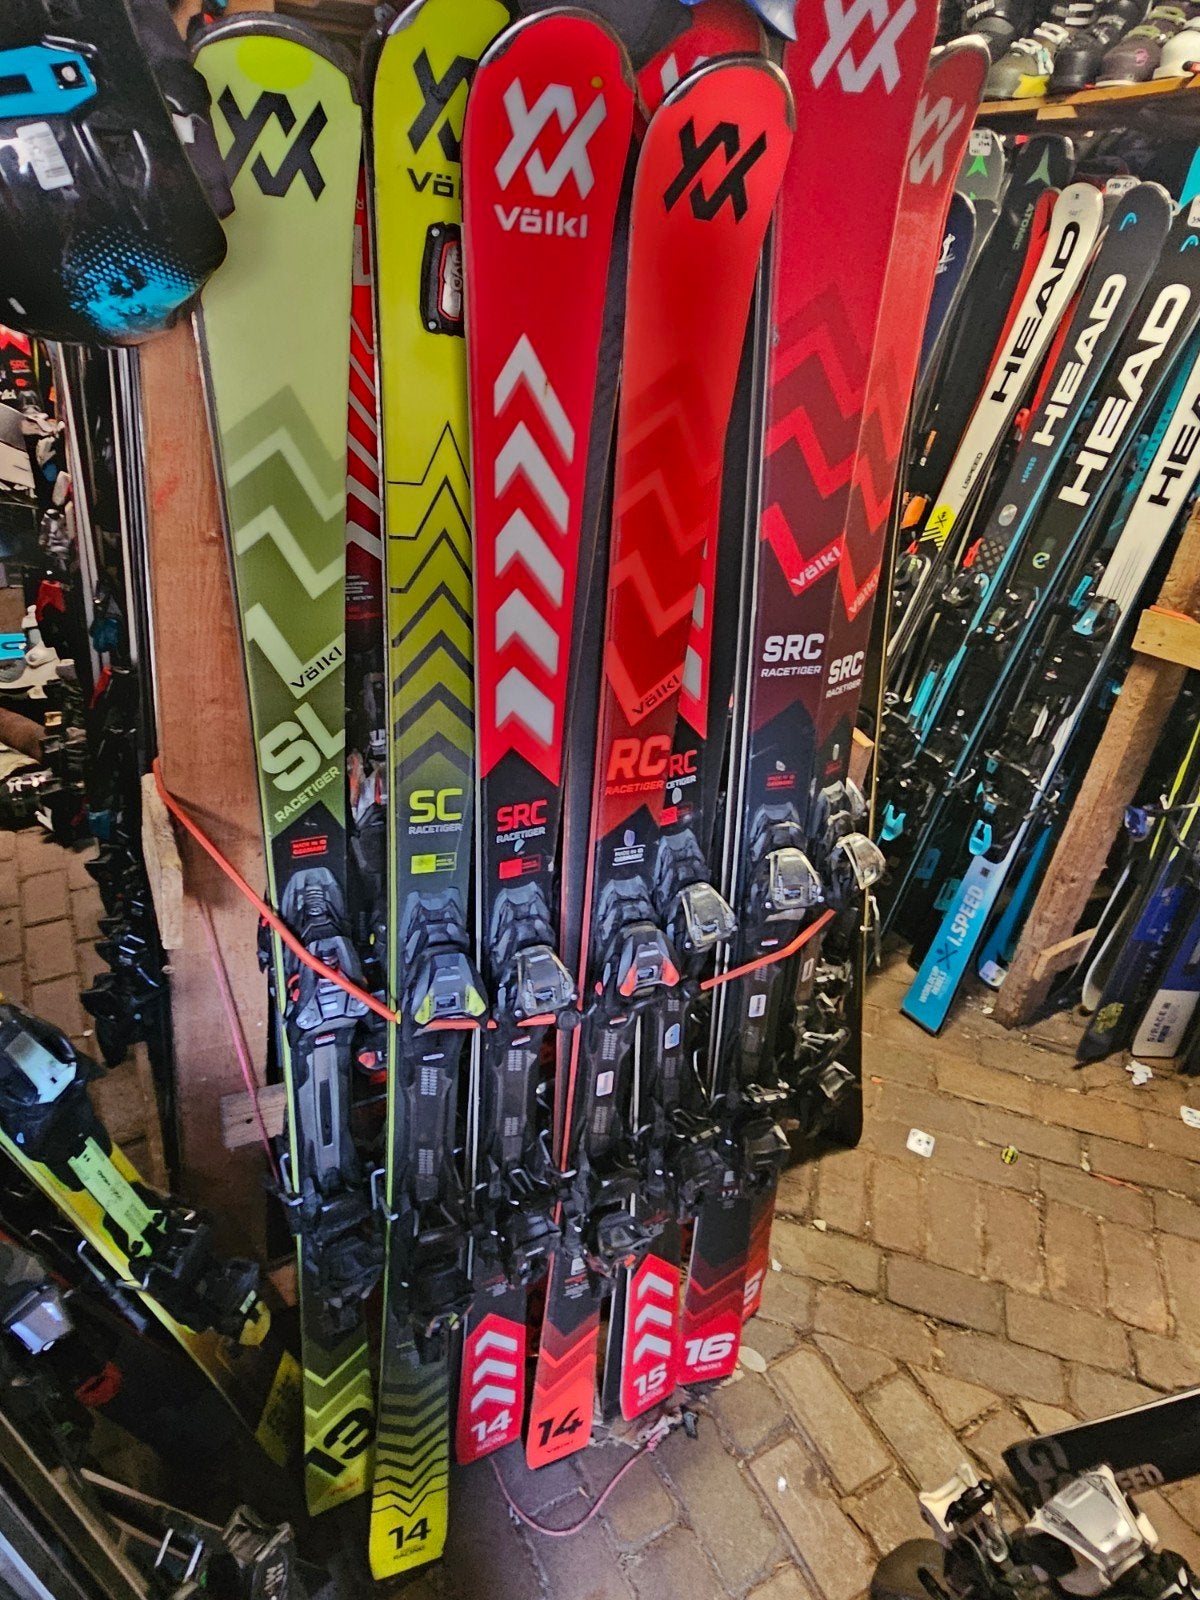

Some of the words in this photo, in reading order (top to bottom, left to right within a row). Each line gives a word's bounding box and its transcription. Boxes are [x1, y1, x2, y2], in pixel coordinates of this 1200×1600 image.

[494, 204, 588, 238] Völkl
[990, 221, 1080, 403] HEAD
[1031, 273, 1127, 447] HEAD
[1058, 283, 1191, 507] HEAD
[1147, 393, 1200, 507] HE
[791, 546, 841, 587] Völkl
[762, 633, 824, 662] SRC
[290, 646, 343, 688] Völkl
[761, 665, 822, 677] RACETIGER
[828, 650, 865, 685] SRC
[632, 674, 680, 715] Völkl
[259, 702, 345, 791] SL
[606, 735, 672, 781] RC
[669, 750, 697, 778] RC
[274, 766, 341, 823] RACETIGER
[605, 780, 664, 796] RACETIGER
[666, 775, 697, 790] CETIGER
[409, 788, 463, 823] SC
[496, 800, 548, 832] SRC
[408, 823, 464, 835] RACETIGER
[496, 826, 546, 844] RACETIGER
[743, 1268, 763, 1306] 5
[684, 1332, 736, 1366] 16
[633, 1362, 667, 1396] 15
[304, 1408, 377, 1477] 13
[471, 1409, 513, 1441] 14
[538, 1407, 583, 1448] 14
[388, 1518, 431, 1550] 14
